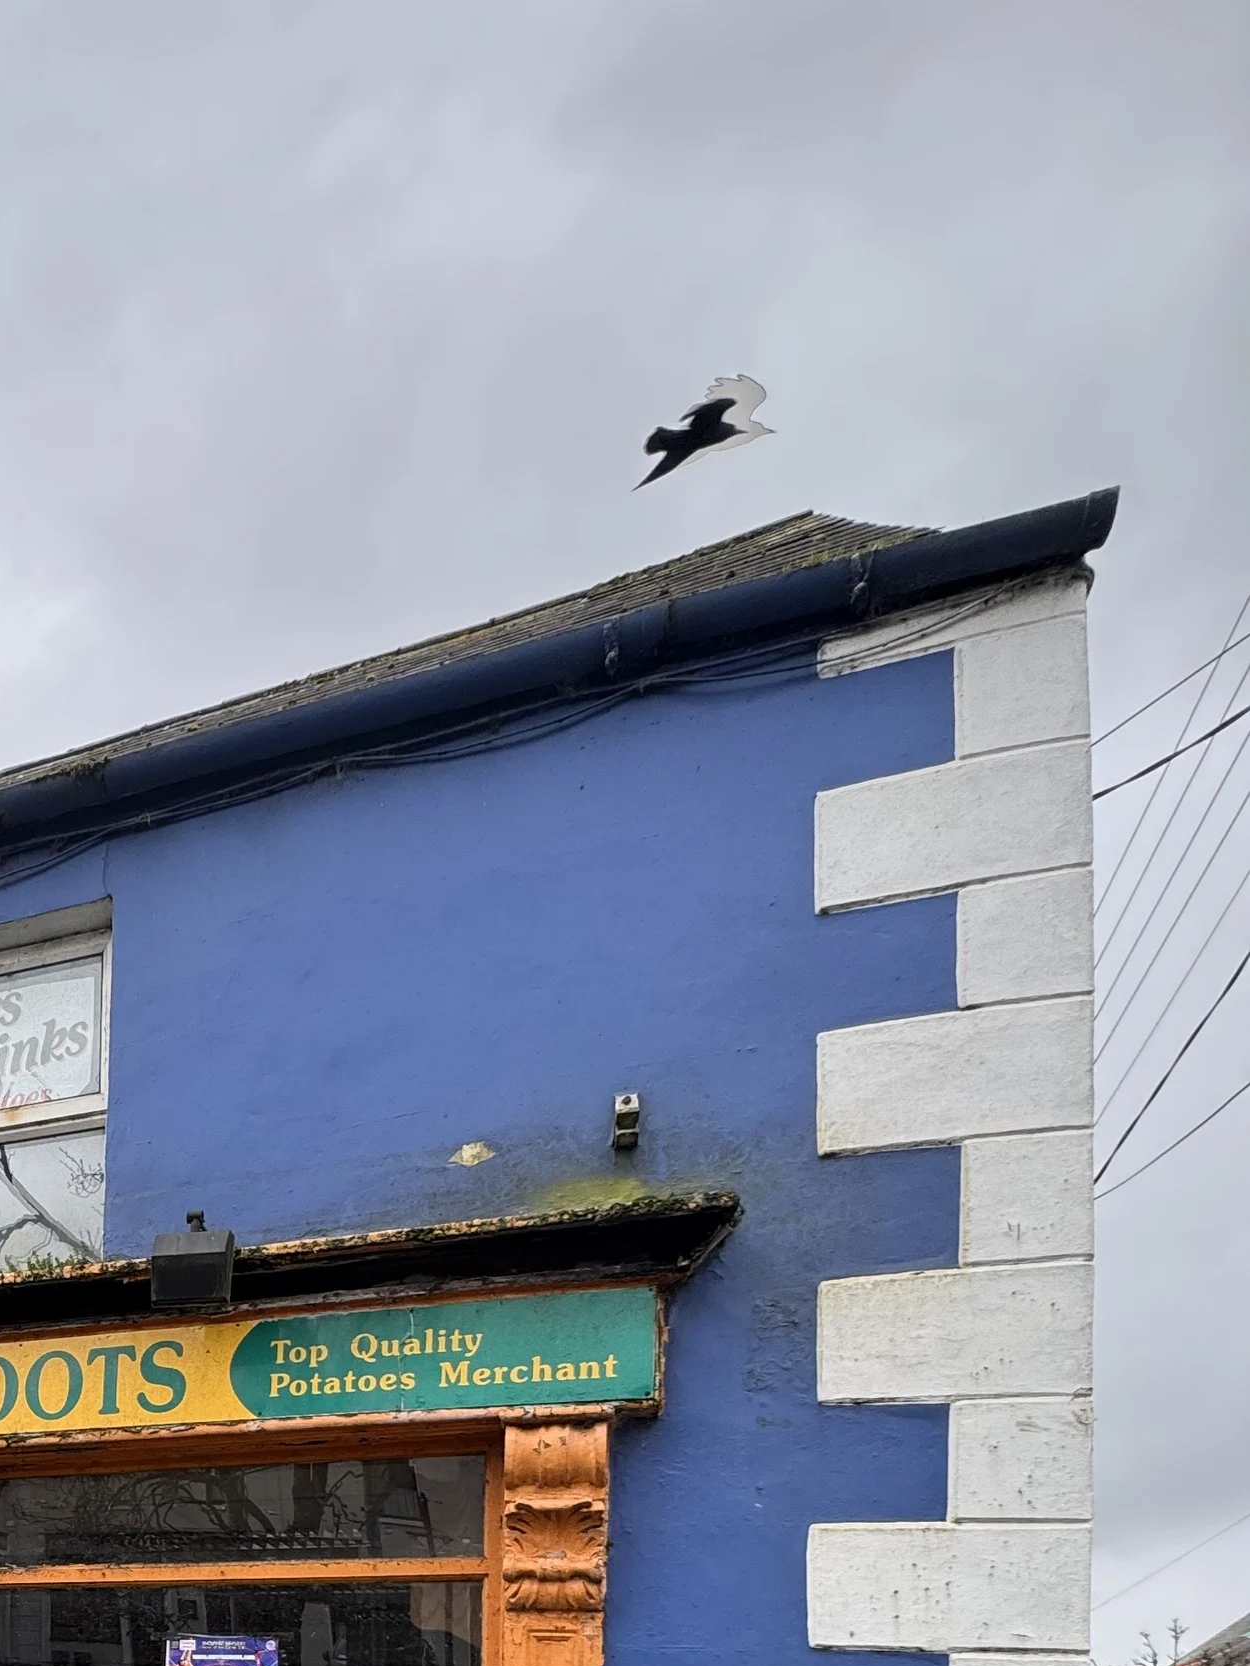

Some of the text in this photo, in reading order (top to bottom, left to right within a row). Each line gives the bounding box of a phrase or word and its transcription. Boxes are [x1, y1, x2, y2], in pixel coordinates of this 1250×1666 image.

[270, 1328, 483, 1367] Top Quality
[269, 1353, 620, 1398] Potatoes Merchant
